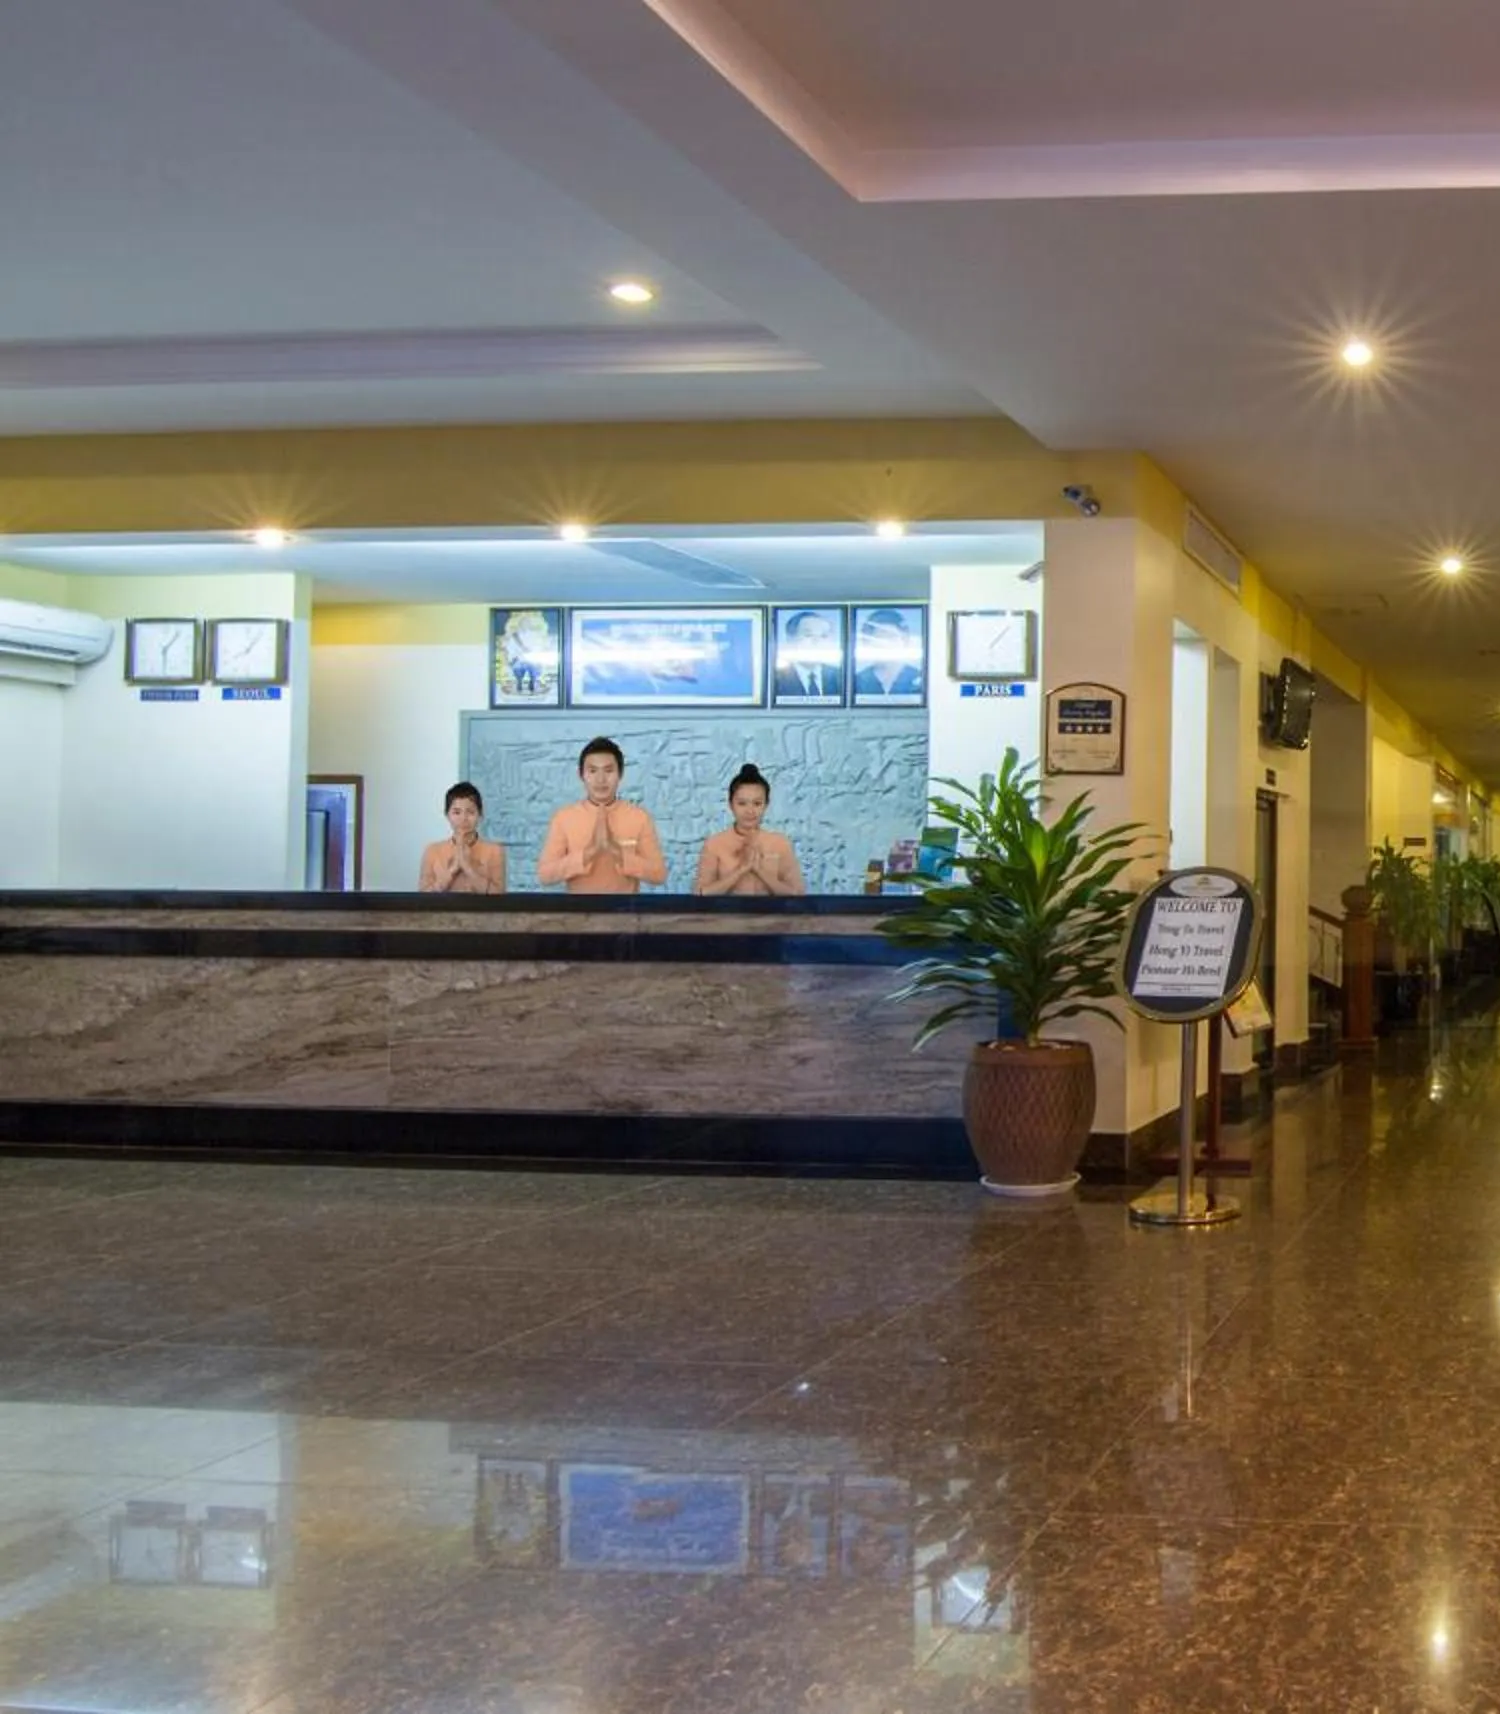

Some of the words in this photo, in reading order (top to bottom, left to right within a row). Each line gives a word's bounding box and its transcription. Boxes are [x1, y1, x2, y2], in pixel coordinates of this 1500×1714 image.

[232, 688, 271, 700] SEOUL
[975, 683, 1012, 697] PARIS
[1157, 901, 1218, 914] WELCOME
[1221, 901, 1238, 914] TO
[1193, 945, 1225, 957] Travel
